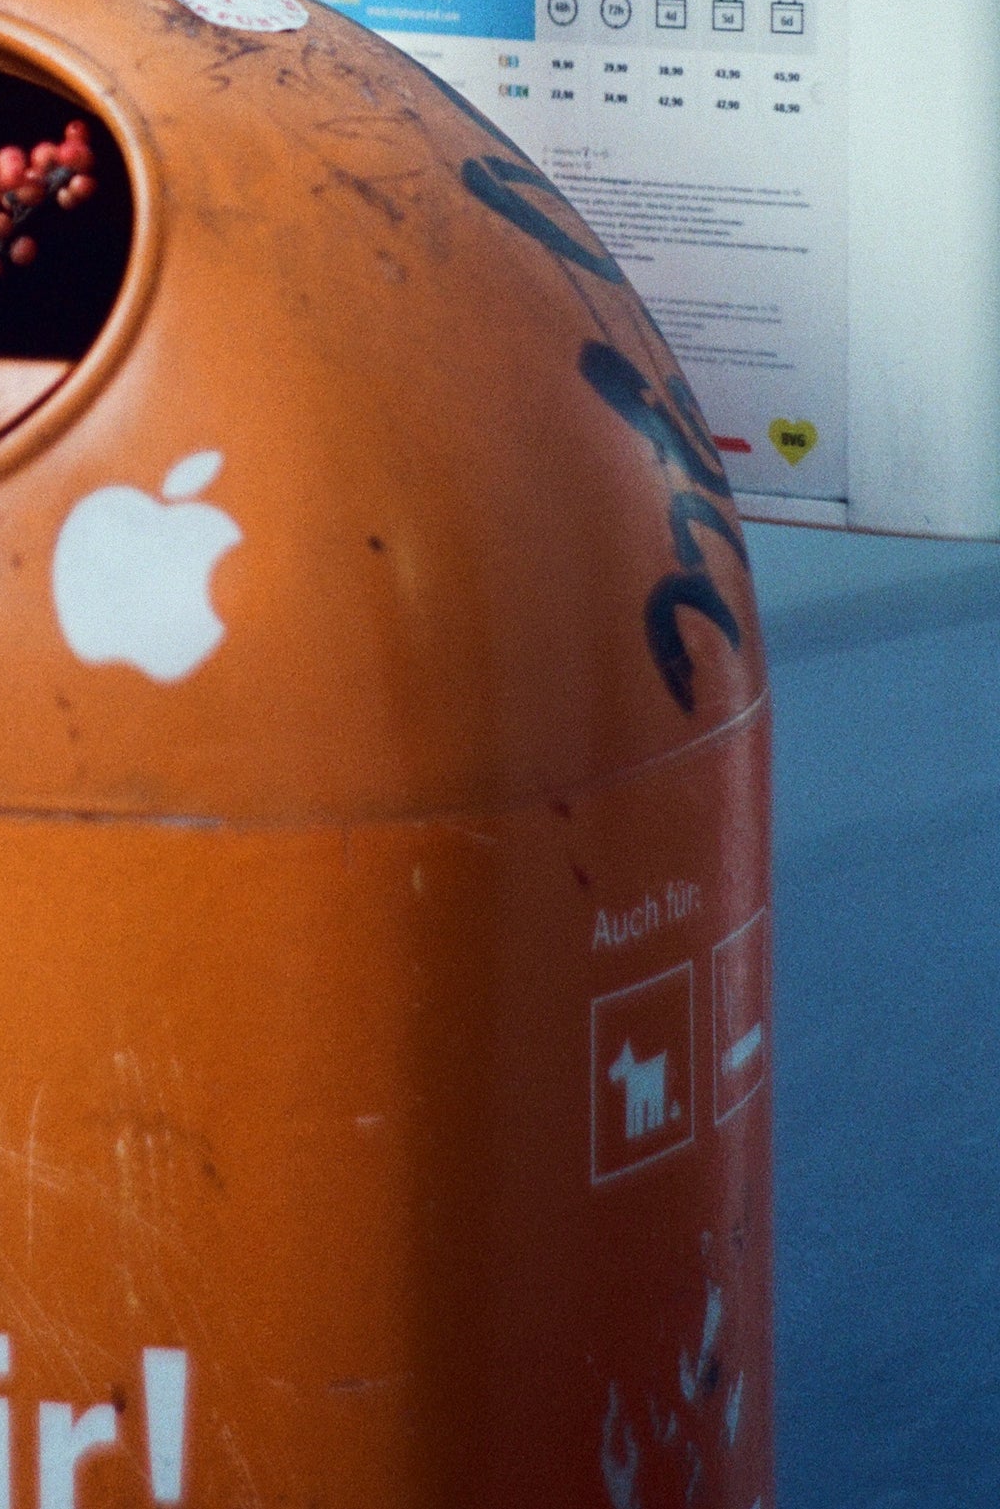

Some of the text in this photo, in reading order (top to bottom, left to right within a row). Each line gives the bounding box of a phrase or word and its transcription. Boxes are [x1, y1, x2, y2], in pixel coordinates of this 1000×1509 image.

[608, 4, 624, 16] 72h
[664, 10, 677, 22] 4d
[721, 13, 735, 24] 5d
[780, 16, 794, 27] 6d
[773, 71, 801, 83] 45,90
[781, 432, 806, 447] BVG
[591, 890, 660, 952] Auch
